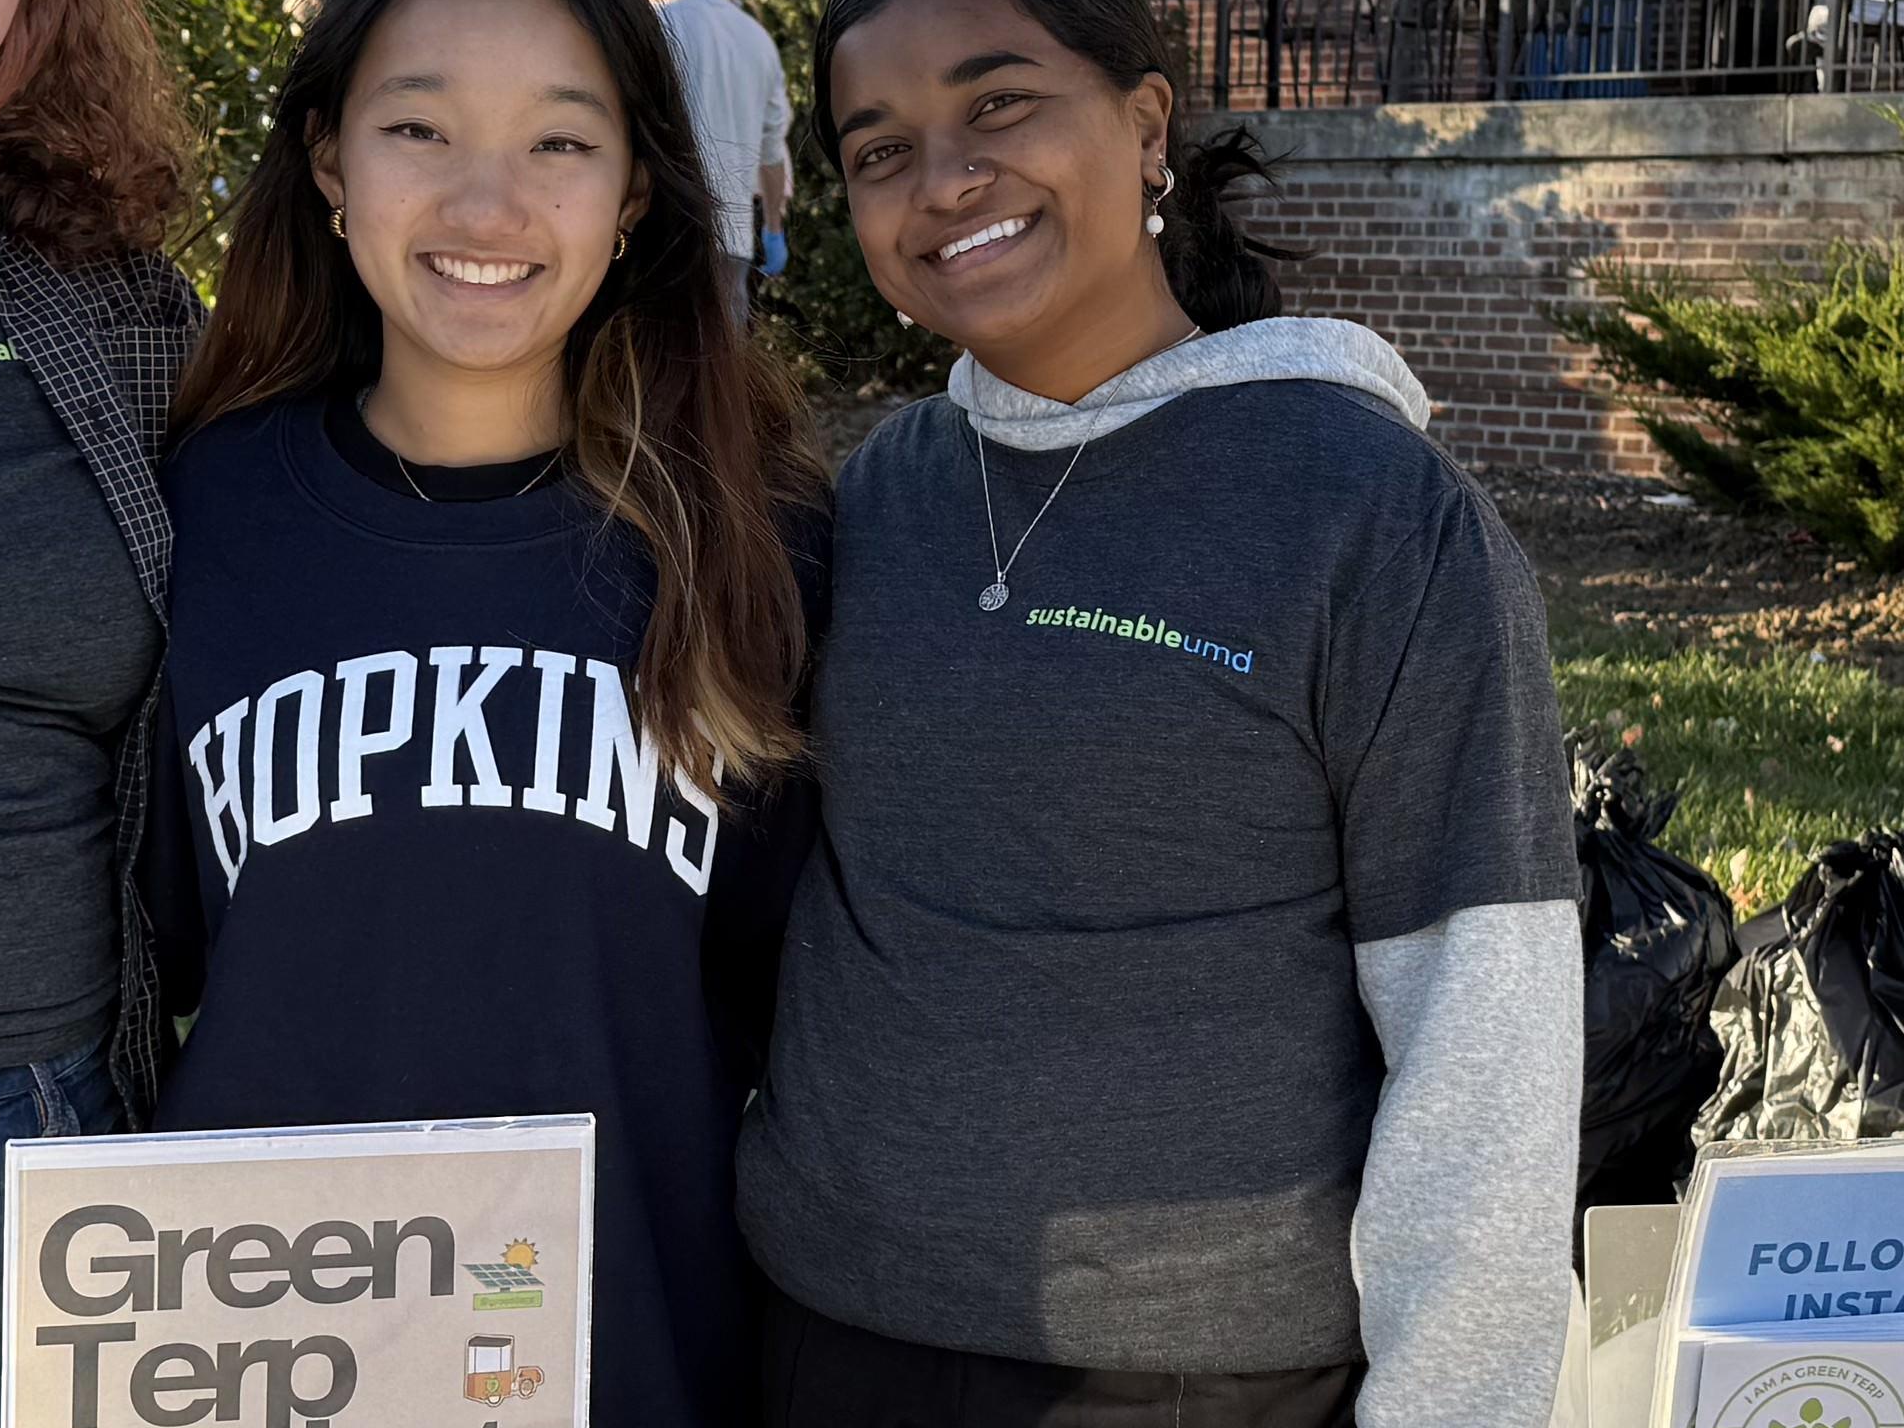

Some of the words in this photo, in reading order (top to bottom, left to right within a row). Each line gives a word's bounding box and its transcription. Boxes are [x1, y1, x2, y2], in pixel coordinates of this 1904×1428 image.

[188, 645, 725, 899] HOPKINS
[38, 1204, 456, 1317] Green
[1744, 1396, 1752, 1404] I
[1754, 1378, 1777, 1399] AM
[1780, 1372, 1792, 1383] A
[1795, 1366, 1848, 1380] GREEN
[1852, 1374, 1885, 1400] TERP
